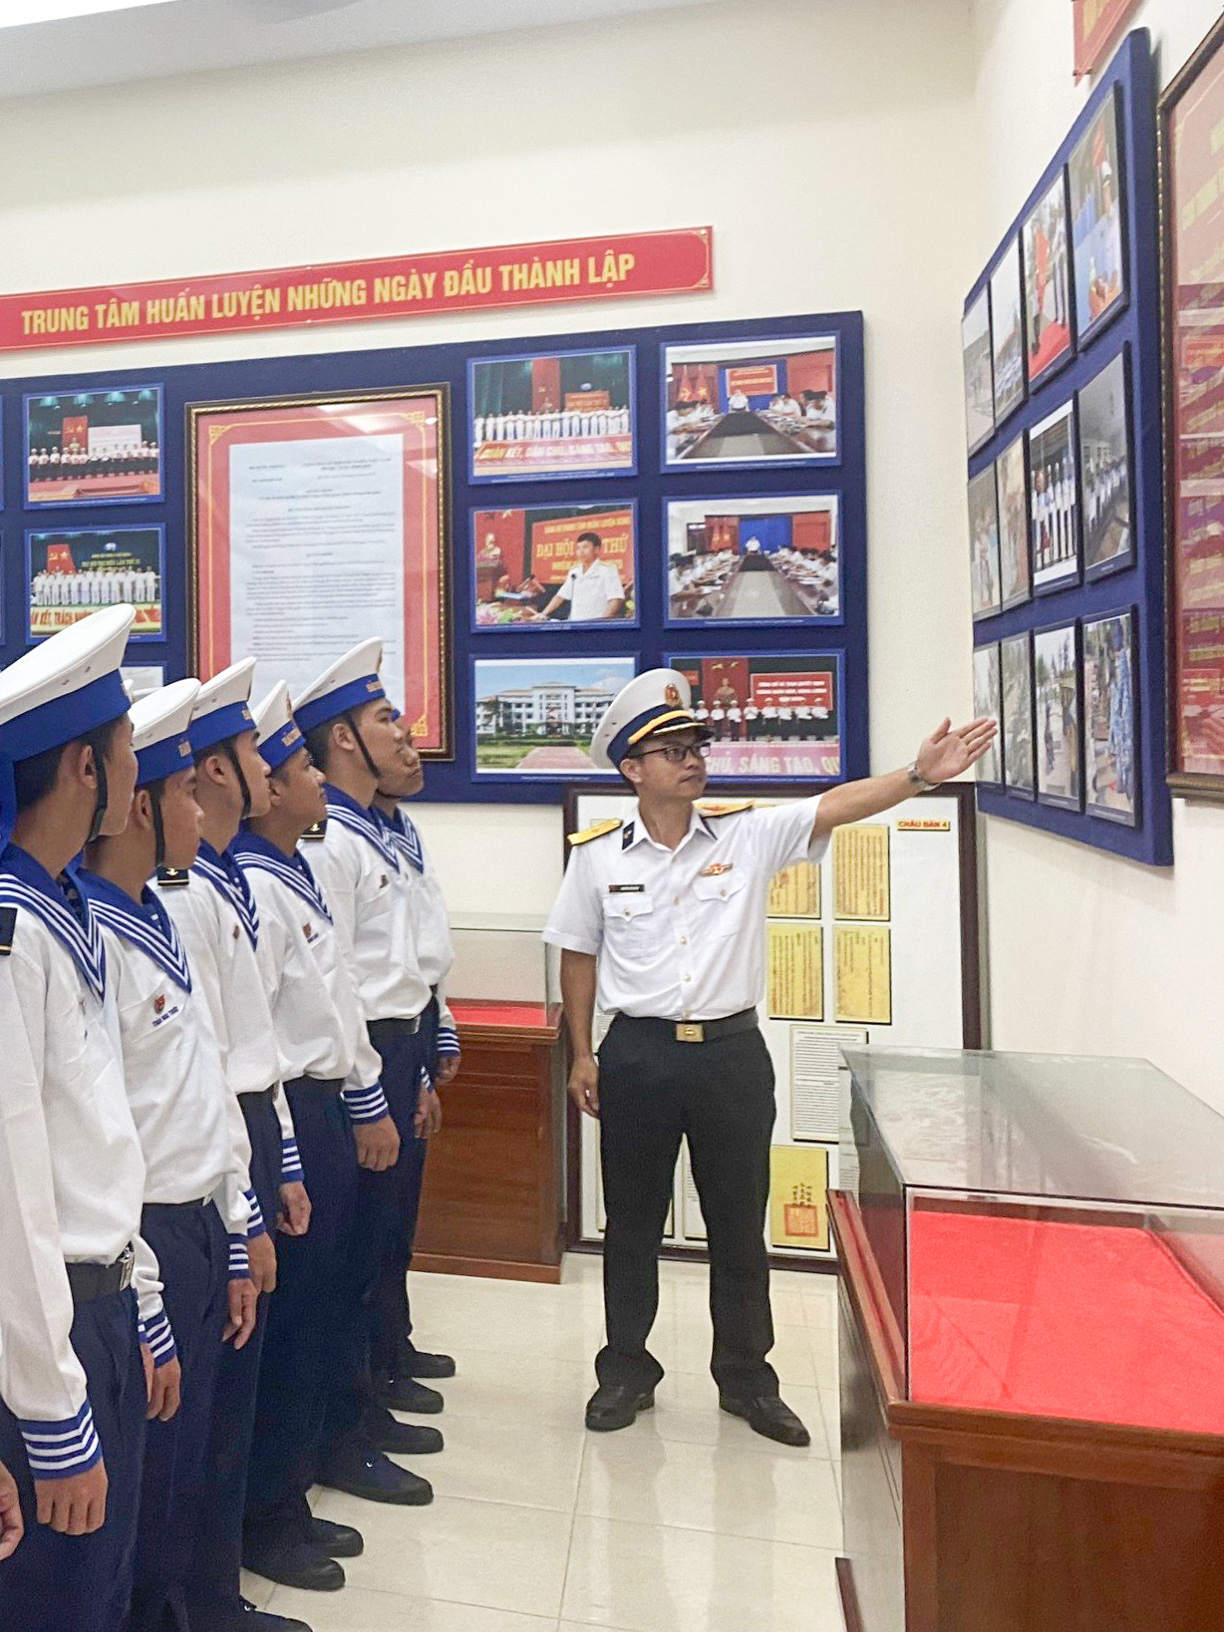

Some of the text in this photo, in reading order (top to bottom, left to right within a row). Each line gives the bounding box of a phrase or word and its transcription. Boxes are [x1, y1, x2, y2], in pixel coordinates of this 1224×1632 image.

[22, 249, 635, 335] TRUNG TÂM HUẤN LUYỆN NHỮNG NGÀY ĐẦU THÀNH LẬP
